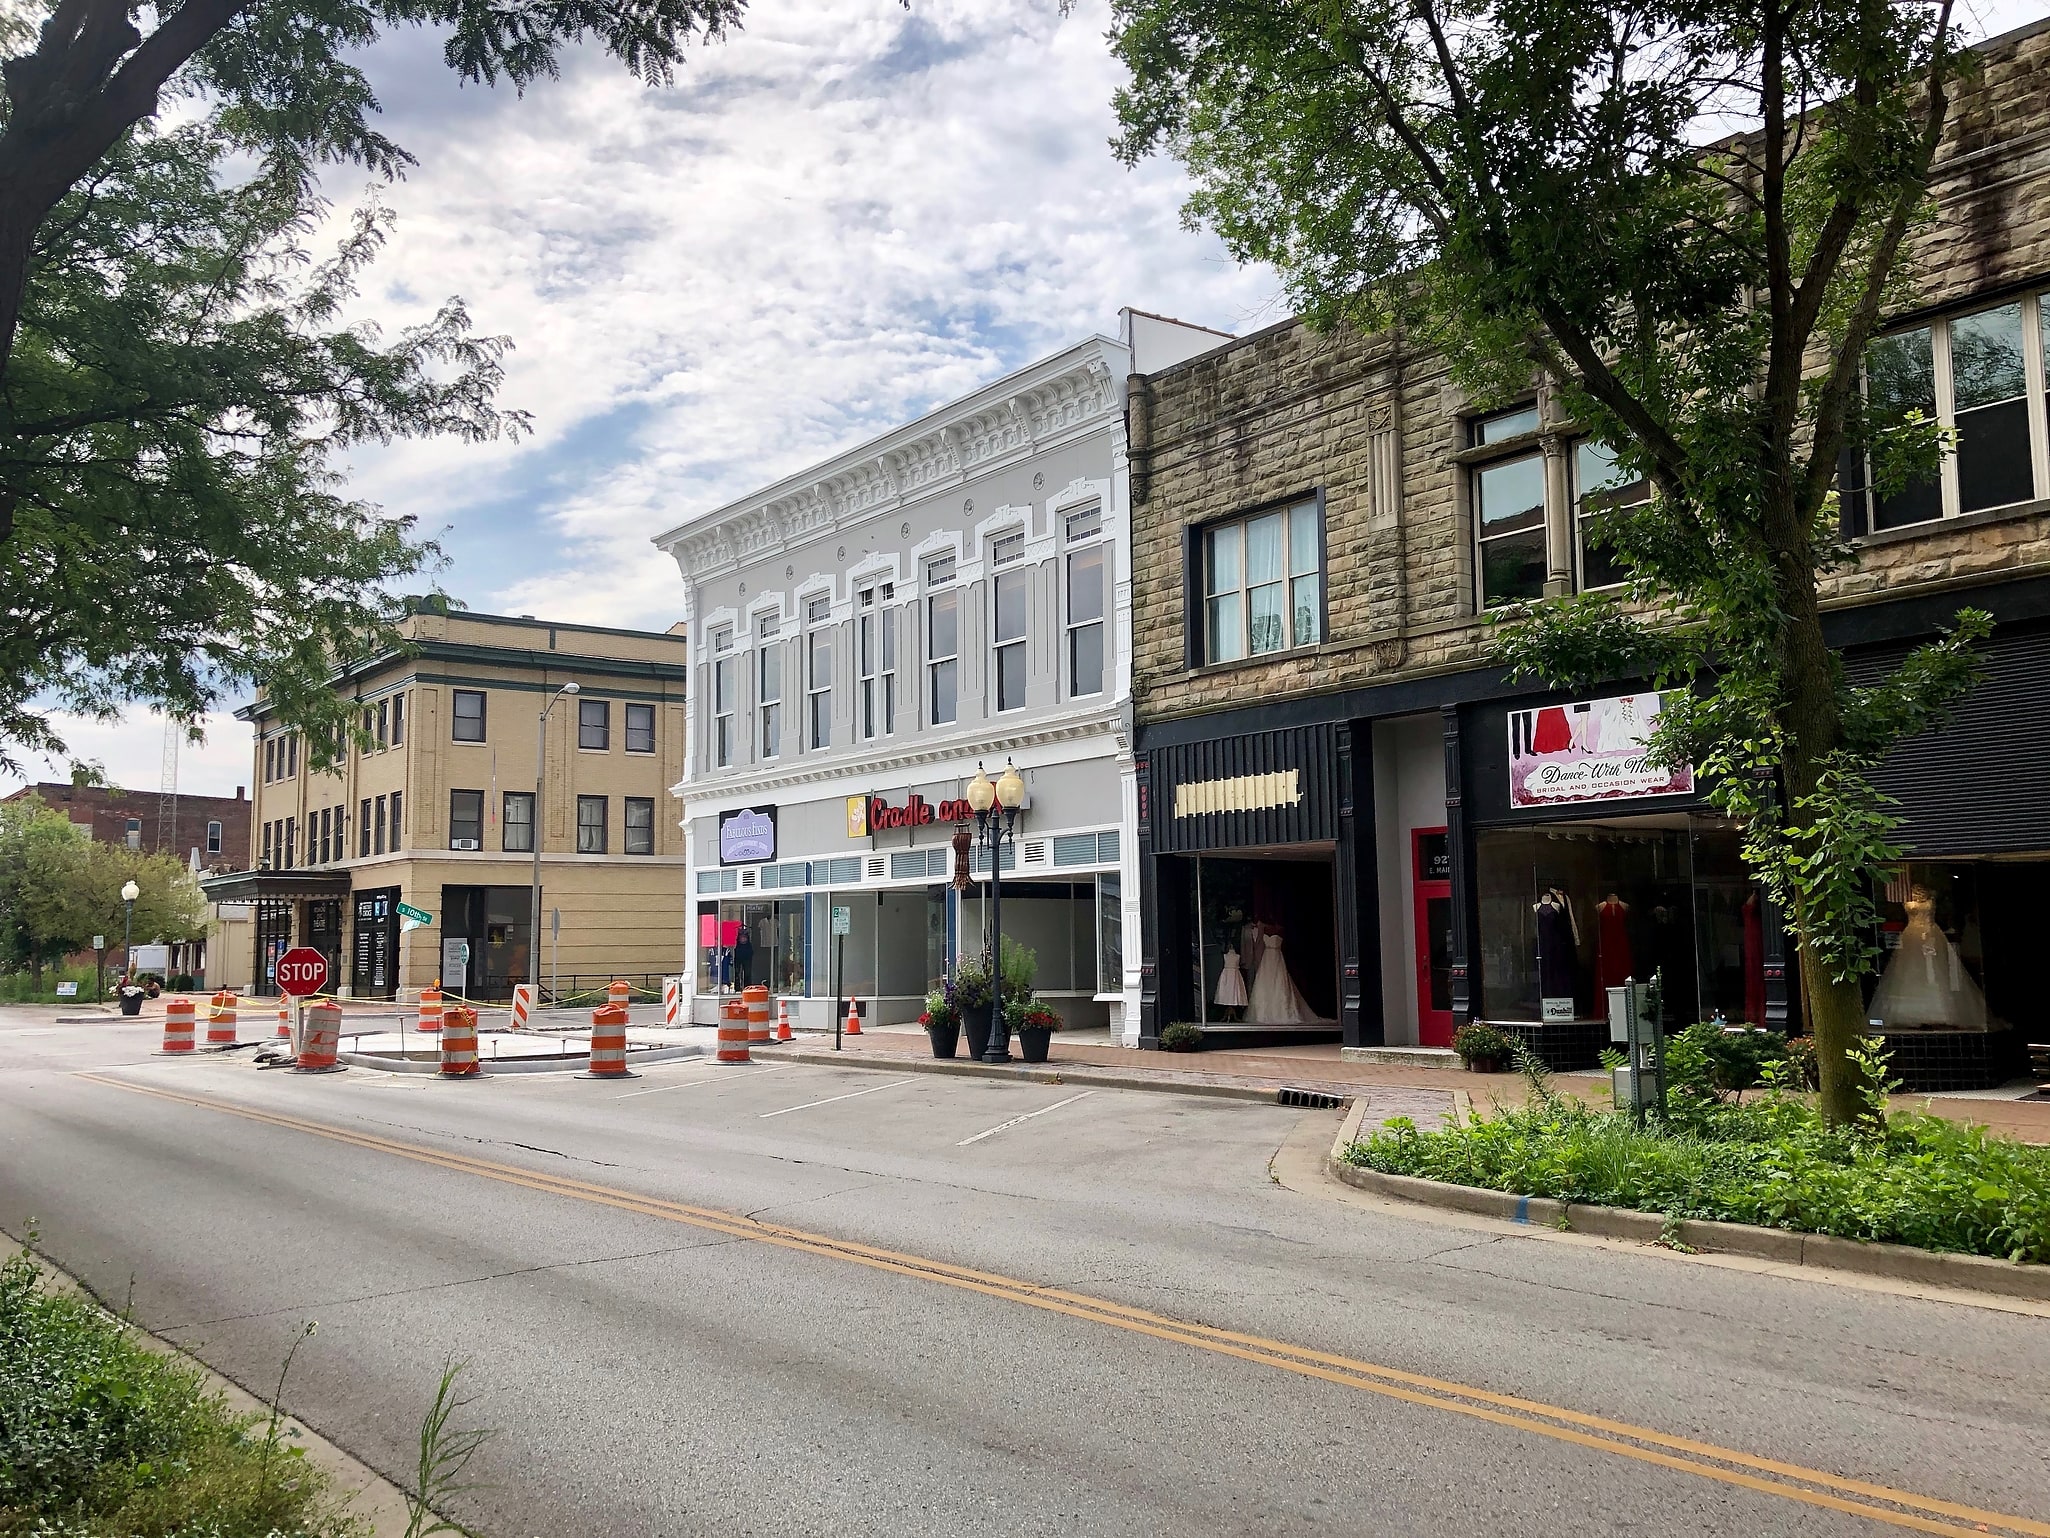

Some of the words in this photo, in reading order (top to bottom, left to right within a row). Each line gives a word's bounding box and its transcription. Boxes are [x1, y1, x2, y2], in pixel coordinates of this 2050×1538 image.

[1579, 762, 1621, 778] With
[1536, 786, 1566, 794] BRIDAL
[1569, 783, 1587, 791] AND
[1591, 779, 1636, 789] OCCASION
[1640, 776, 1665, 784] WEAR
[871, 794, 932, 831] Cradle
[1433, 855, 1450, 865] 92
[406, 908, 421, 919] 10th
[280, 963, 324, 981] STOP
